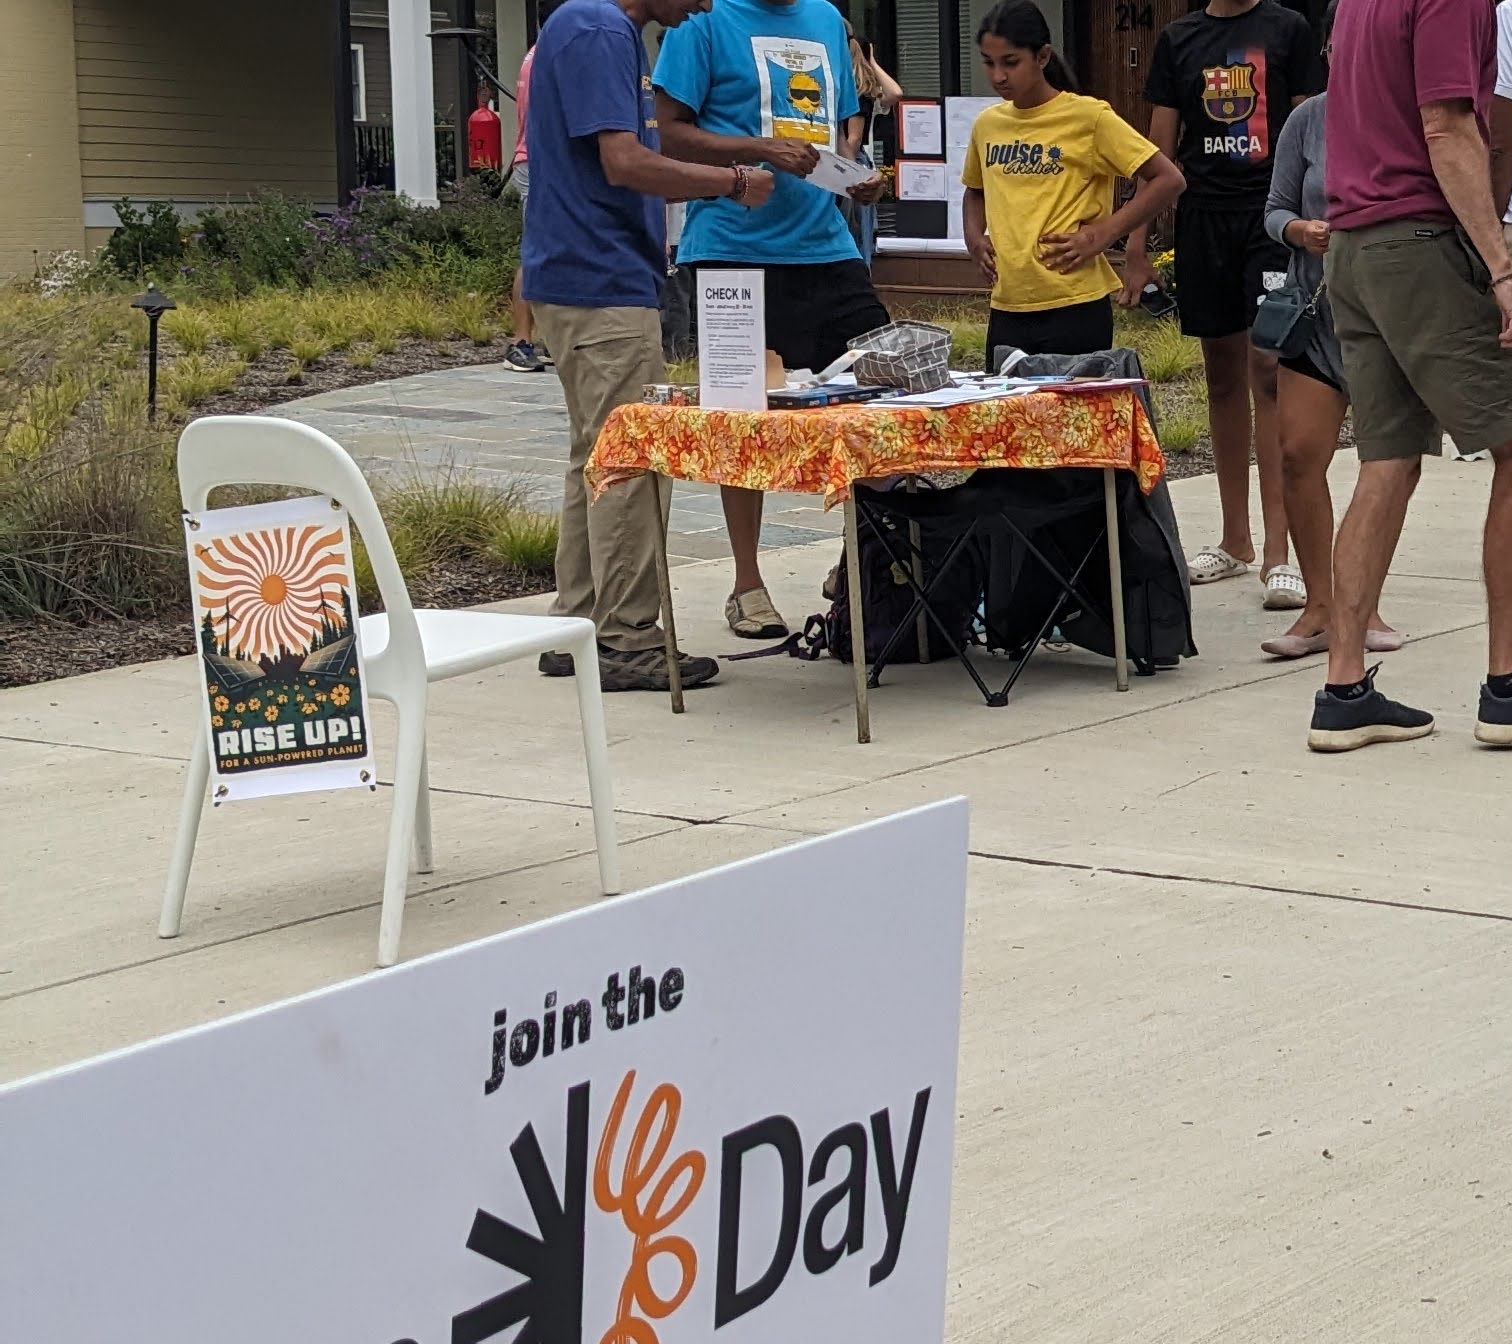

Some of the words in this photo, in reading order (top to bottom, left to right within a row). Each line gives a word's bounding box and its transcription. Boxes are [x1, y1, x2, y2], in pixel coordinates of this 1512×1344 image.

[1115, 4, 1153, 32] 214
[985, 139, 1044, 168] Louise
[1203, 135, 1262, 156] BARÇA
[705, 287, 739, 301] CHECK
[741, 287, 751, 301] IN
[217, 723, 298, 756] RISE
[303, 715, 362, 746] UP!
[220, 759, 240, 769] FOR
[243, 757, 251, 766] A
[253, 749, 324, 765] SUN-POWERED
[327, 743, 364, 757] PLANET
[484, 990, 592, 1096] join
[601, 964, 685, 1031] the
[714, 1086, 932, 1331] Day
